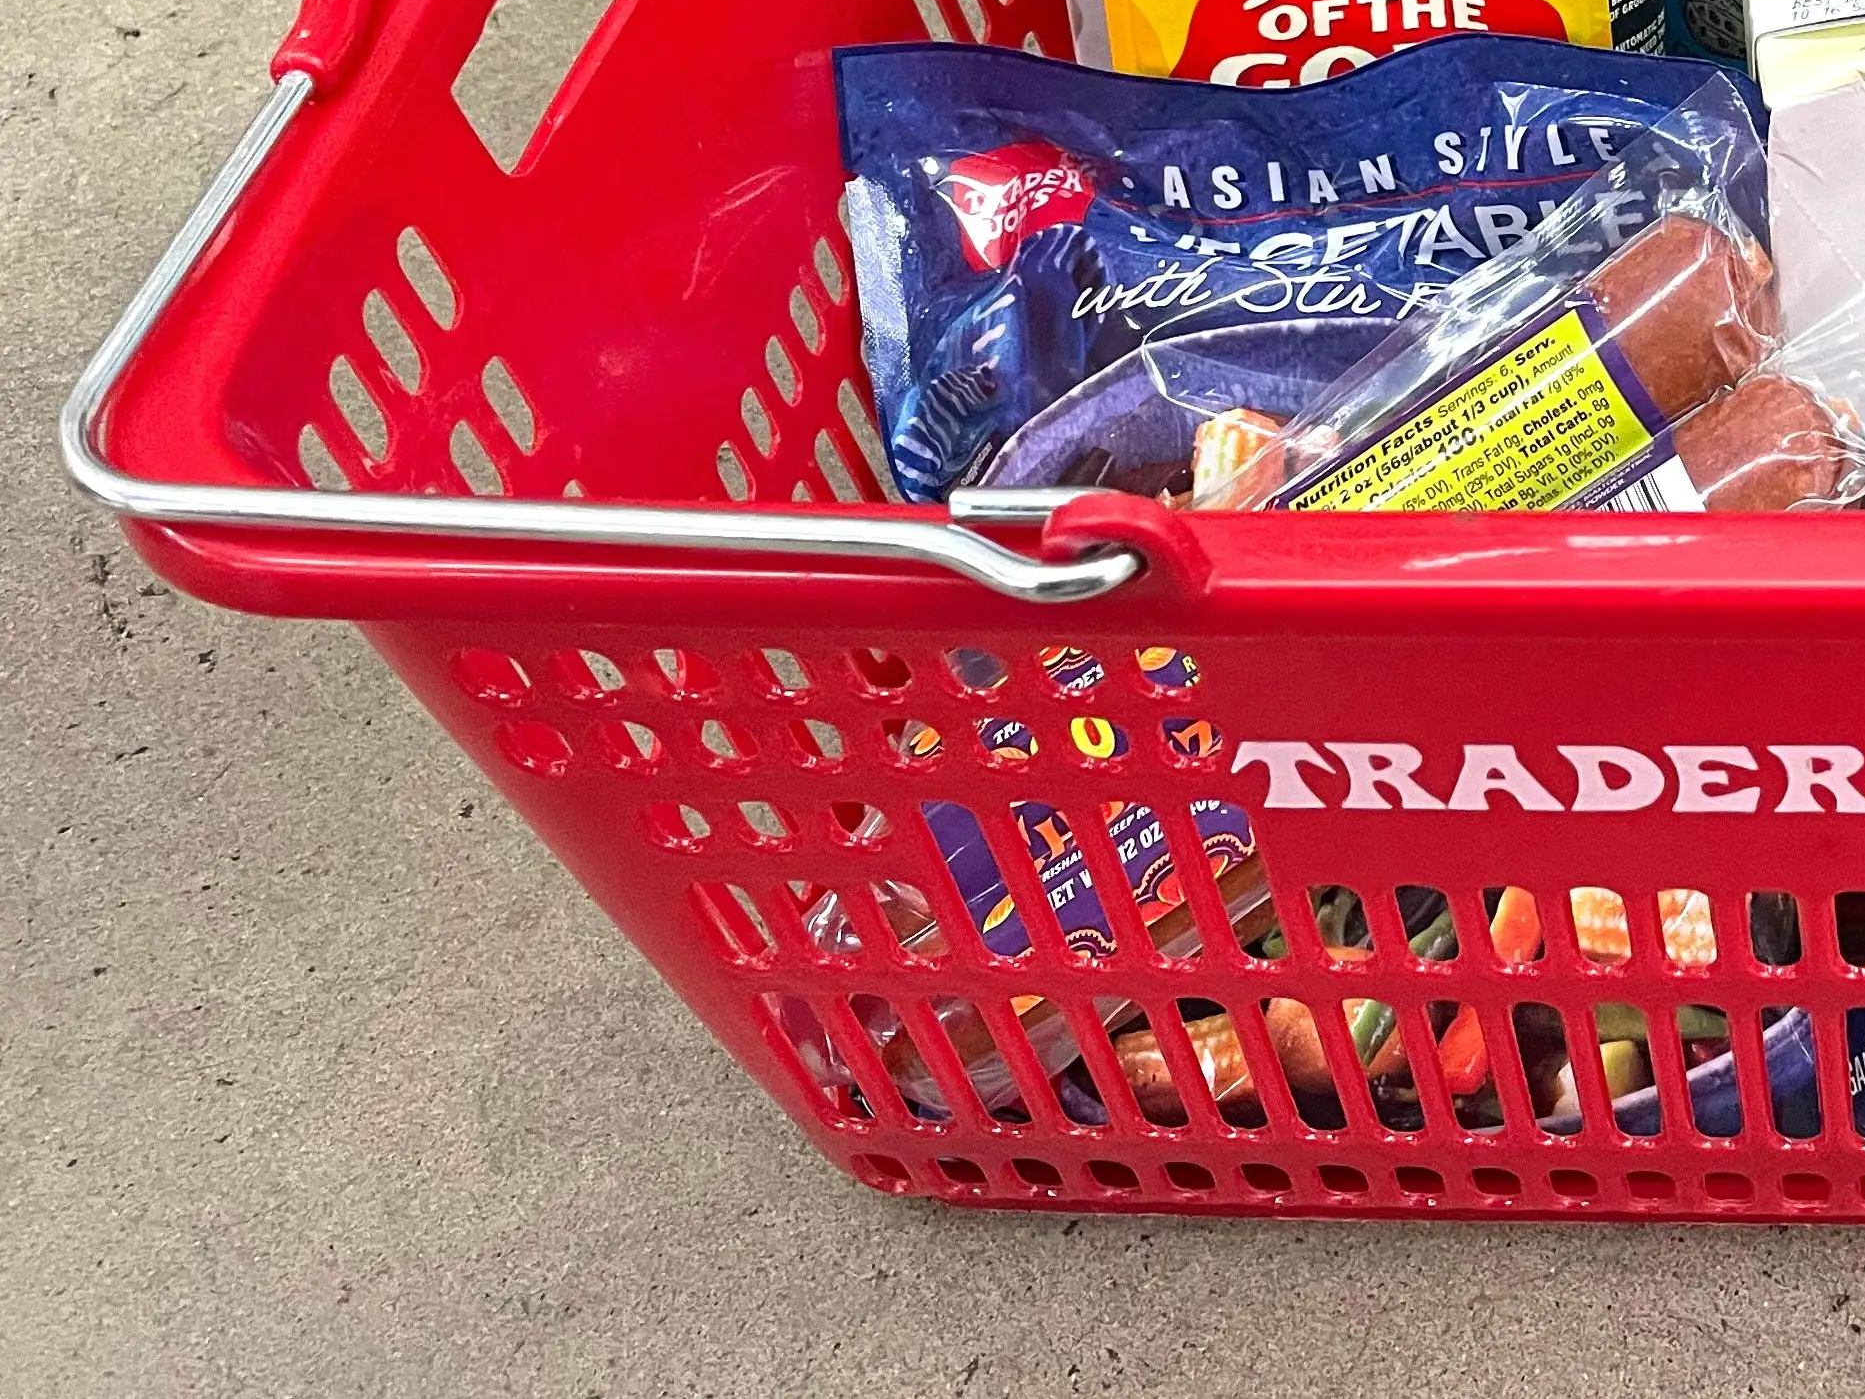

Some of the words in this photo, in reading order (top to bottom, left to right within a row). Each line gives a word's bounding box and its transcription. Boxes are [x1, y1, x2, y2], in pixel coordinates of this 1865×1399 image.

[1610, 6, 1619, 23] OF
[963, 167, 1084, 215] TRADER
[1162, 152, 1397, 210] ASIAN
[1433, 122, 1622, 177] STYLE
[1071, 256, 1224, 319] with
[1234, 257, 1381, 314] Stir
[1294, 451, 1379, 513] Nutrition
[1381, 414, 1435, 454] Facts
[1436, 376, 1500, 418] Servings:
[1514, 337, 1557, 367] Serv.
[1341, 487, 1353, 503] 2
[1354, 478, 1374, 495] oz
[1375, 417, 1460, 482] (56g/about
[1461, 400, 1487, 424] 1/3
[1489, 374, 1531, 409] cup),
[1531, 344, 1575, 379] Amount
[1487, 409, 1522, 433] Total
[1523, 389, 1547, 411] Fat
[1562, 362, 1586, 386] (9%
[1426, 477, 1455, 501] DV),
[1452, 454, 1486, 486] Trans
[1484, 441, 1505, 463] Fat
[1522, 395, 1578, 436] Cholest.
[1577, 378, 1605, 402] 0mg
[1464, 470, 1495, 498] (29%
[1493, 454, 1522, 481] DV),
[1517, 435, 1556, 459] Total
[1556, 408, 1592, 439] Carb.
[1592, 396, 1610, 414] 8g
[1485, 482, 1517, 503] Total
[1515, 455, 1556, 484] Sugars
[1554, 446, 1570, 463] 1g
[1570, 425, 1601, 451] (Incl.
[1569, 448, 1594, 469] (0%
[1592, 431, 1620, 453] DV),
[1563, 466, 1593, 491] (10%
[1117, 840, 1140, 864] 12
[1139, 820, 1165, 849] OZ
